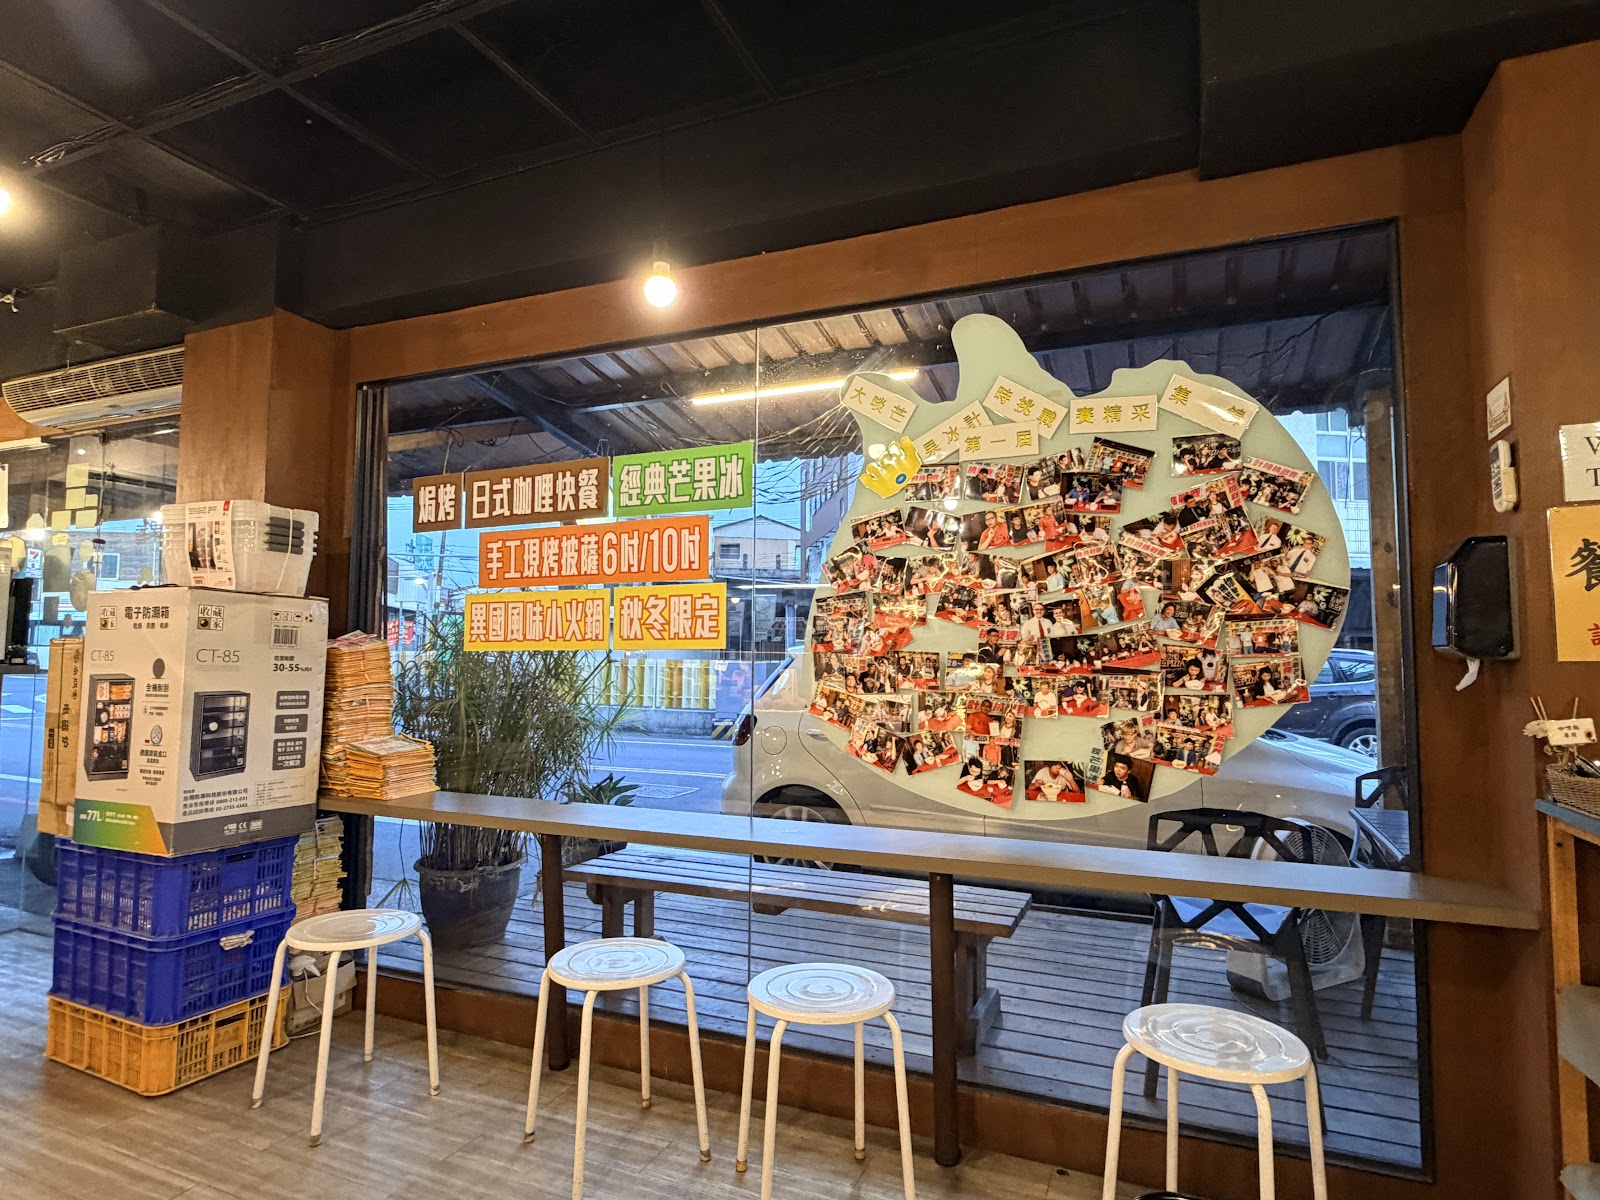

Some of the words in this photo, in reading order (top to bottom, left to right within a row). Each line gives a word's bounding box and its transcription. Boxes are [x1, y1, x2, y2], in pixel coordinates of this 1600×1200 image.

[849, 386, 908, 423] 大啖芒
[993, 386, 1058, 428] 時挑戰
[1076, 403, 1151, 424] 賽精采
[964, 430, 1033, 453] 第一屆
[471, 468, 600, 519] 日式咖哩快餐
[619, 454, 745, 508] 經典芒果冰
[418, 483, 456, 524] 焗烤
[486, 526, 702, 581] 手工現烤披薩6吋/10吋
[124, 606, 170, 620] 電子防潮箱
[469, 598, 605, 643] 異國風味小火鍋
[619, 593, 720, 641] 秋冬限定
[90, 650, 115, 661] CT-85
[196, 648, 240, 663] CT-85
